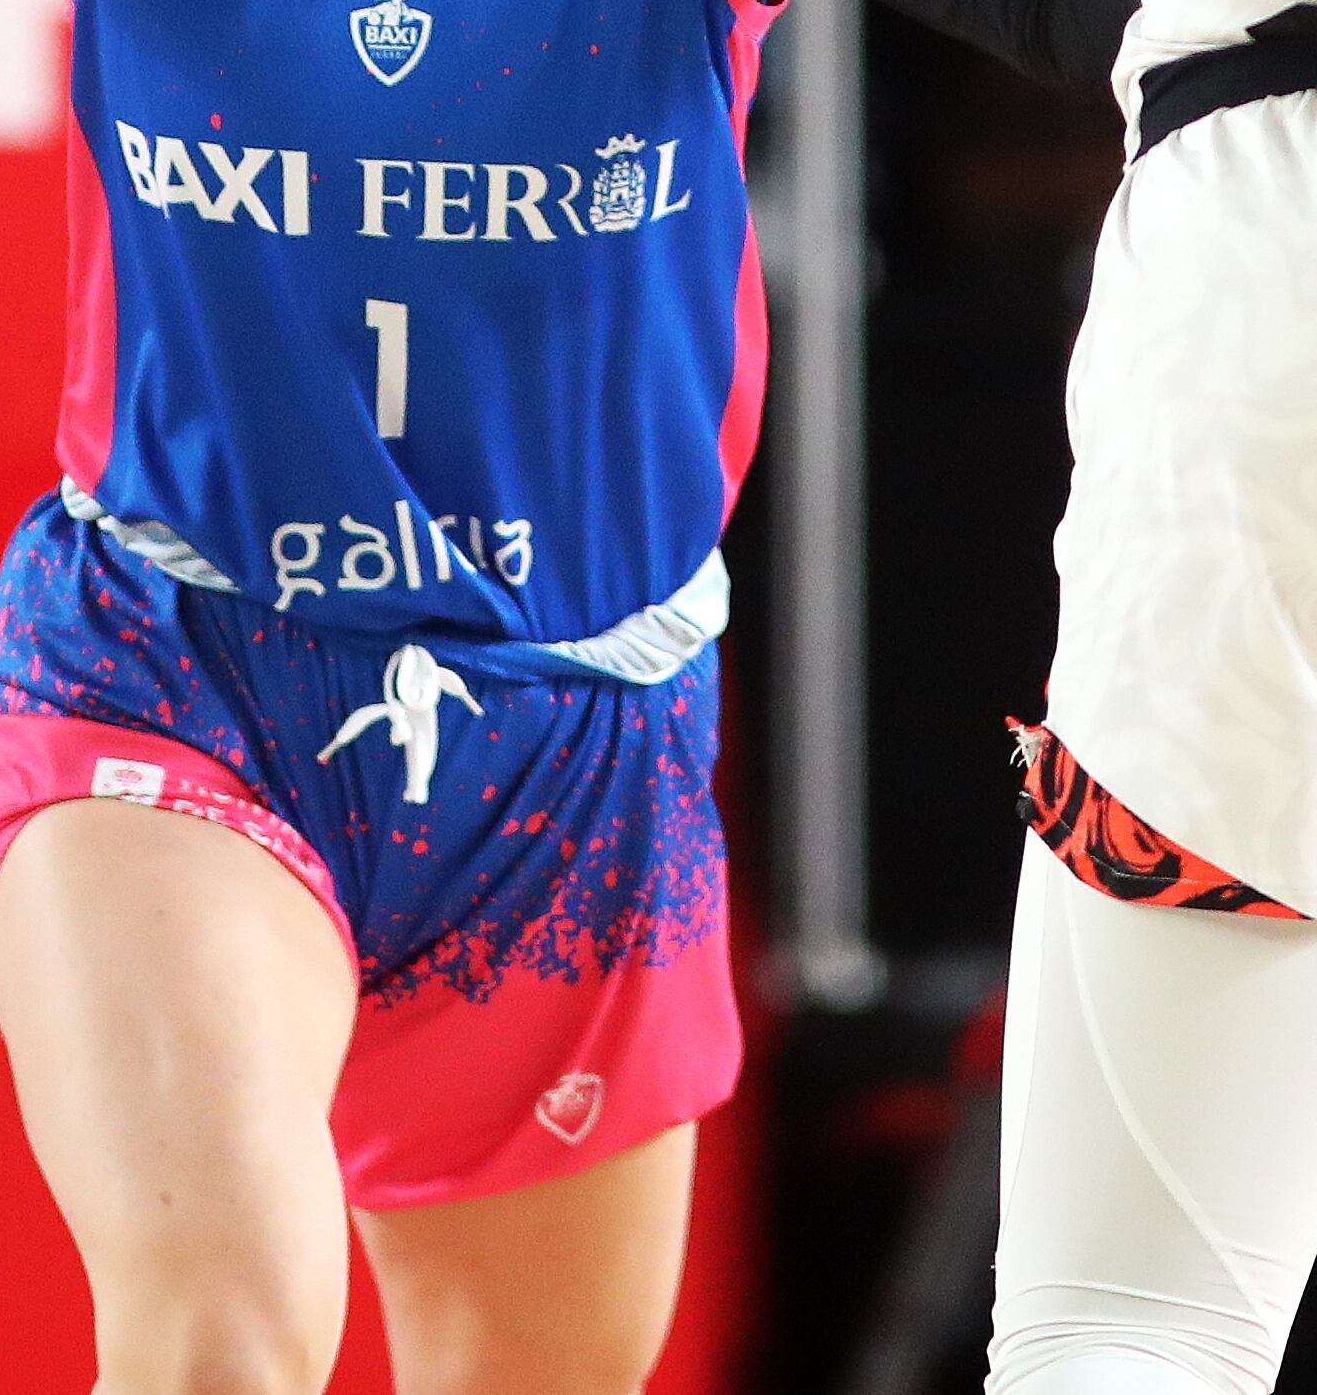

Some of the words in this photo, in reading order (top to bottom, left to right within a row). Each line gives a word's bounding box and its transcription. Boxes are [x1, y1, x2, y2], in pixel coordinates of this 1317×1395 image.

[365, 25, 418, 45] BAXI
[116, 119, 309, 237] BAXI
[365, 298, 408, 439] 1
